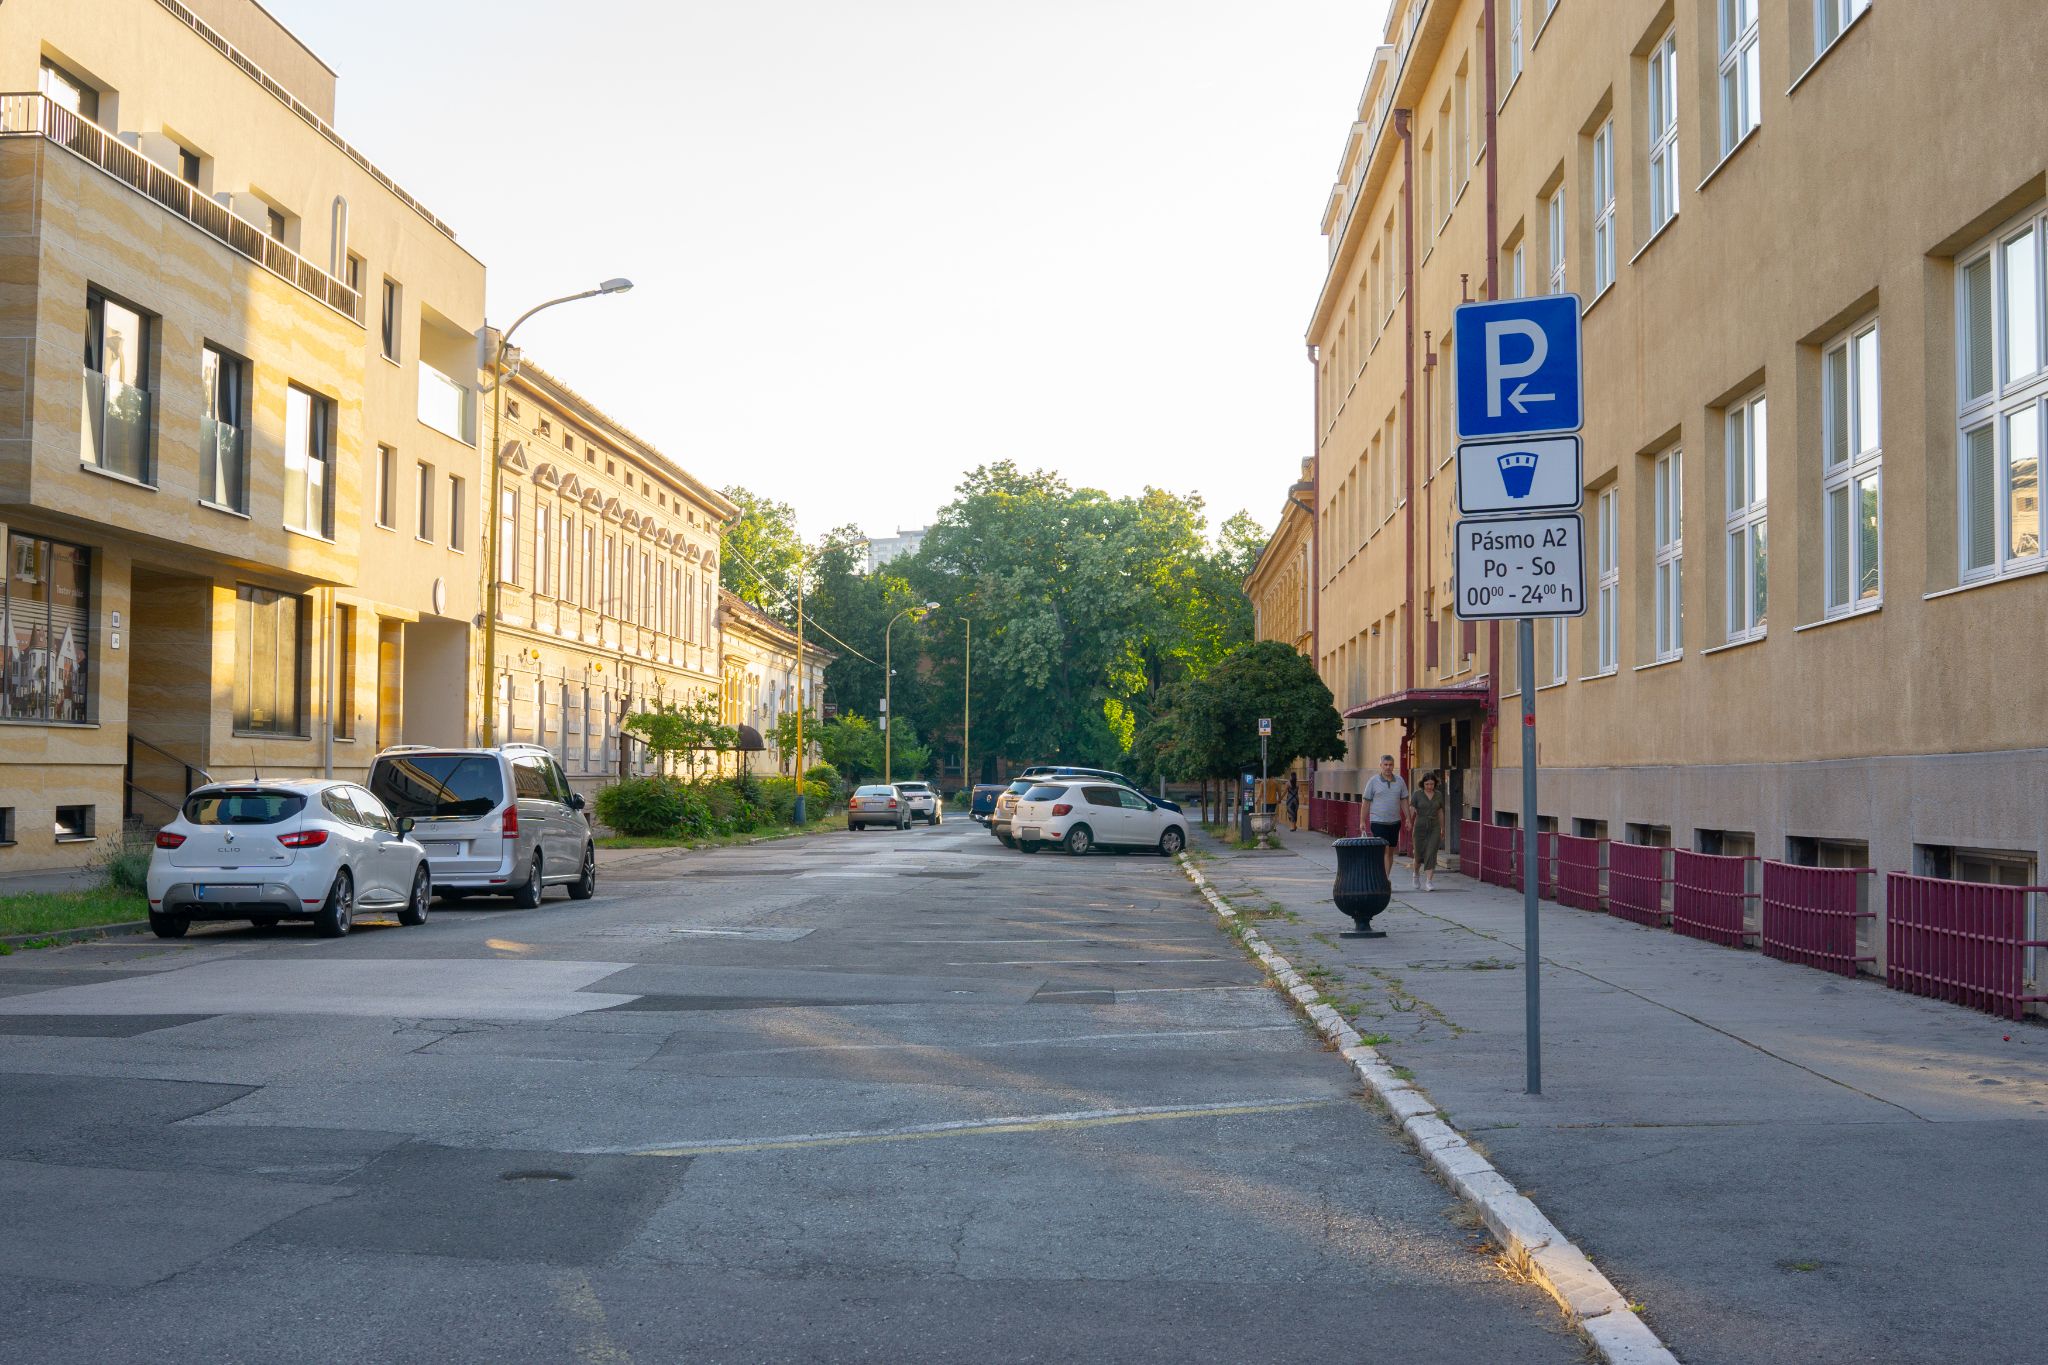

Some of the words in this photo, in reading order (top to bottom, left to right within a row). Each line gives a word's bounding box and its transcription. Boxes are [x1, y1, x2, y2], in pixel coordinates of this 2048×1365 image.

[1485, 318, 1548, 418] P
[1471, 530, 1535, 551] Pásmo
[1543, 527, 1567, 548] A2
[1484, 559, 1507, 578] Po
[1531, 556, 1556, 576] So
[1561, 583, 1573, 603] h
